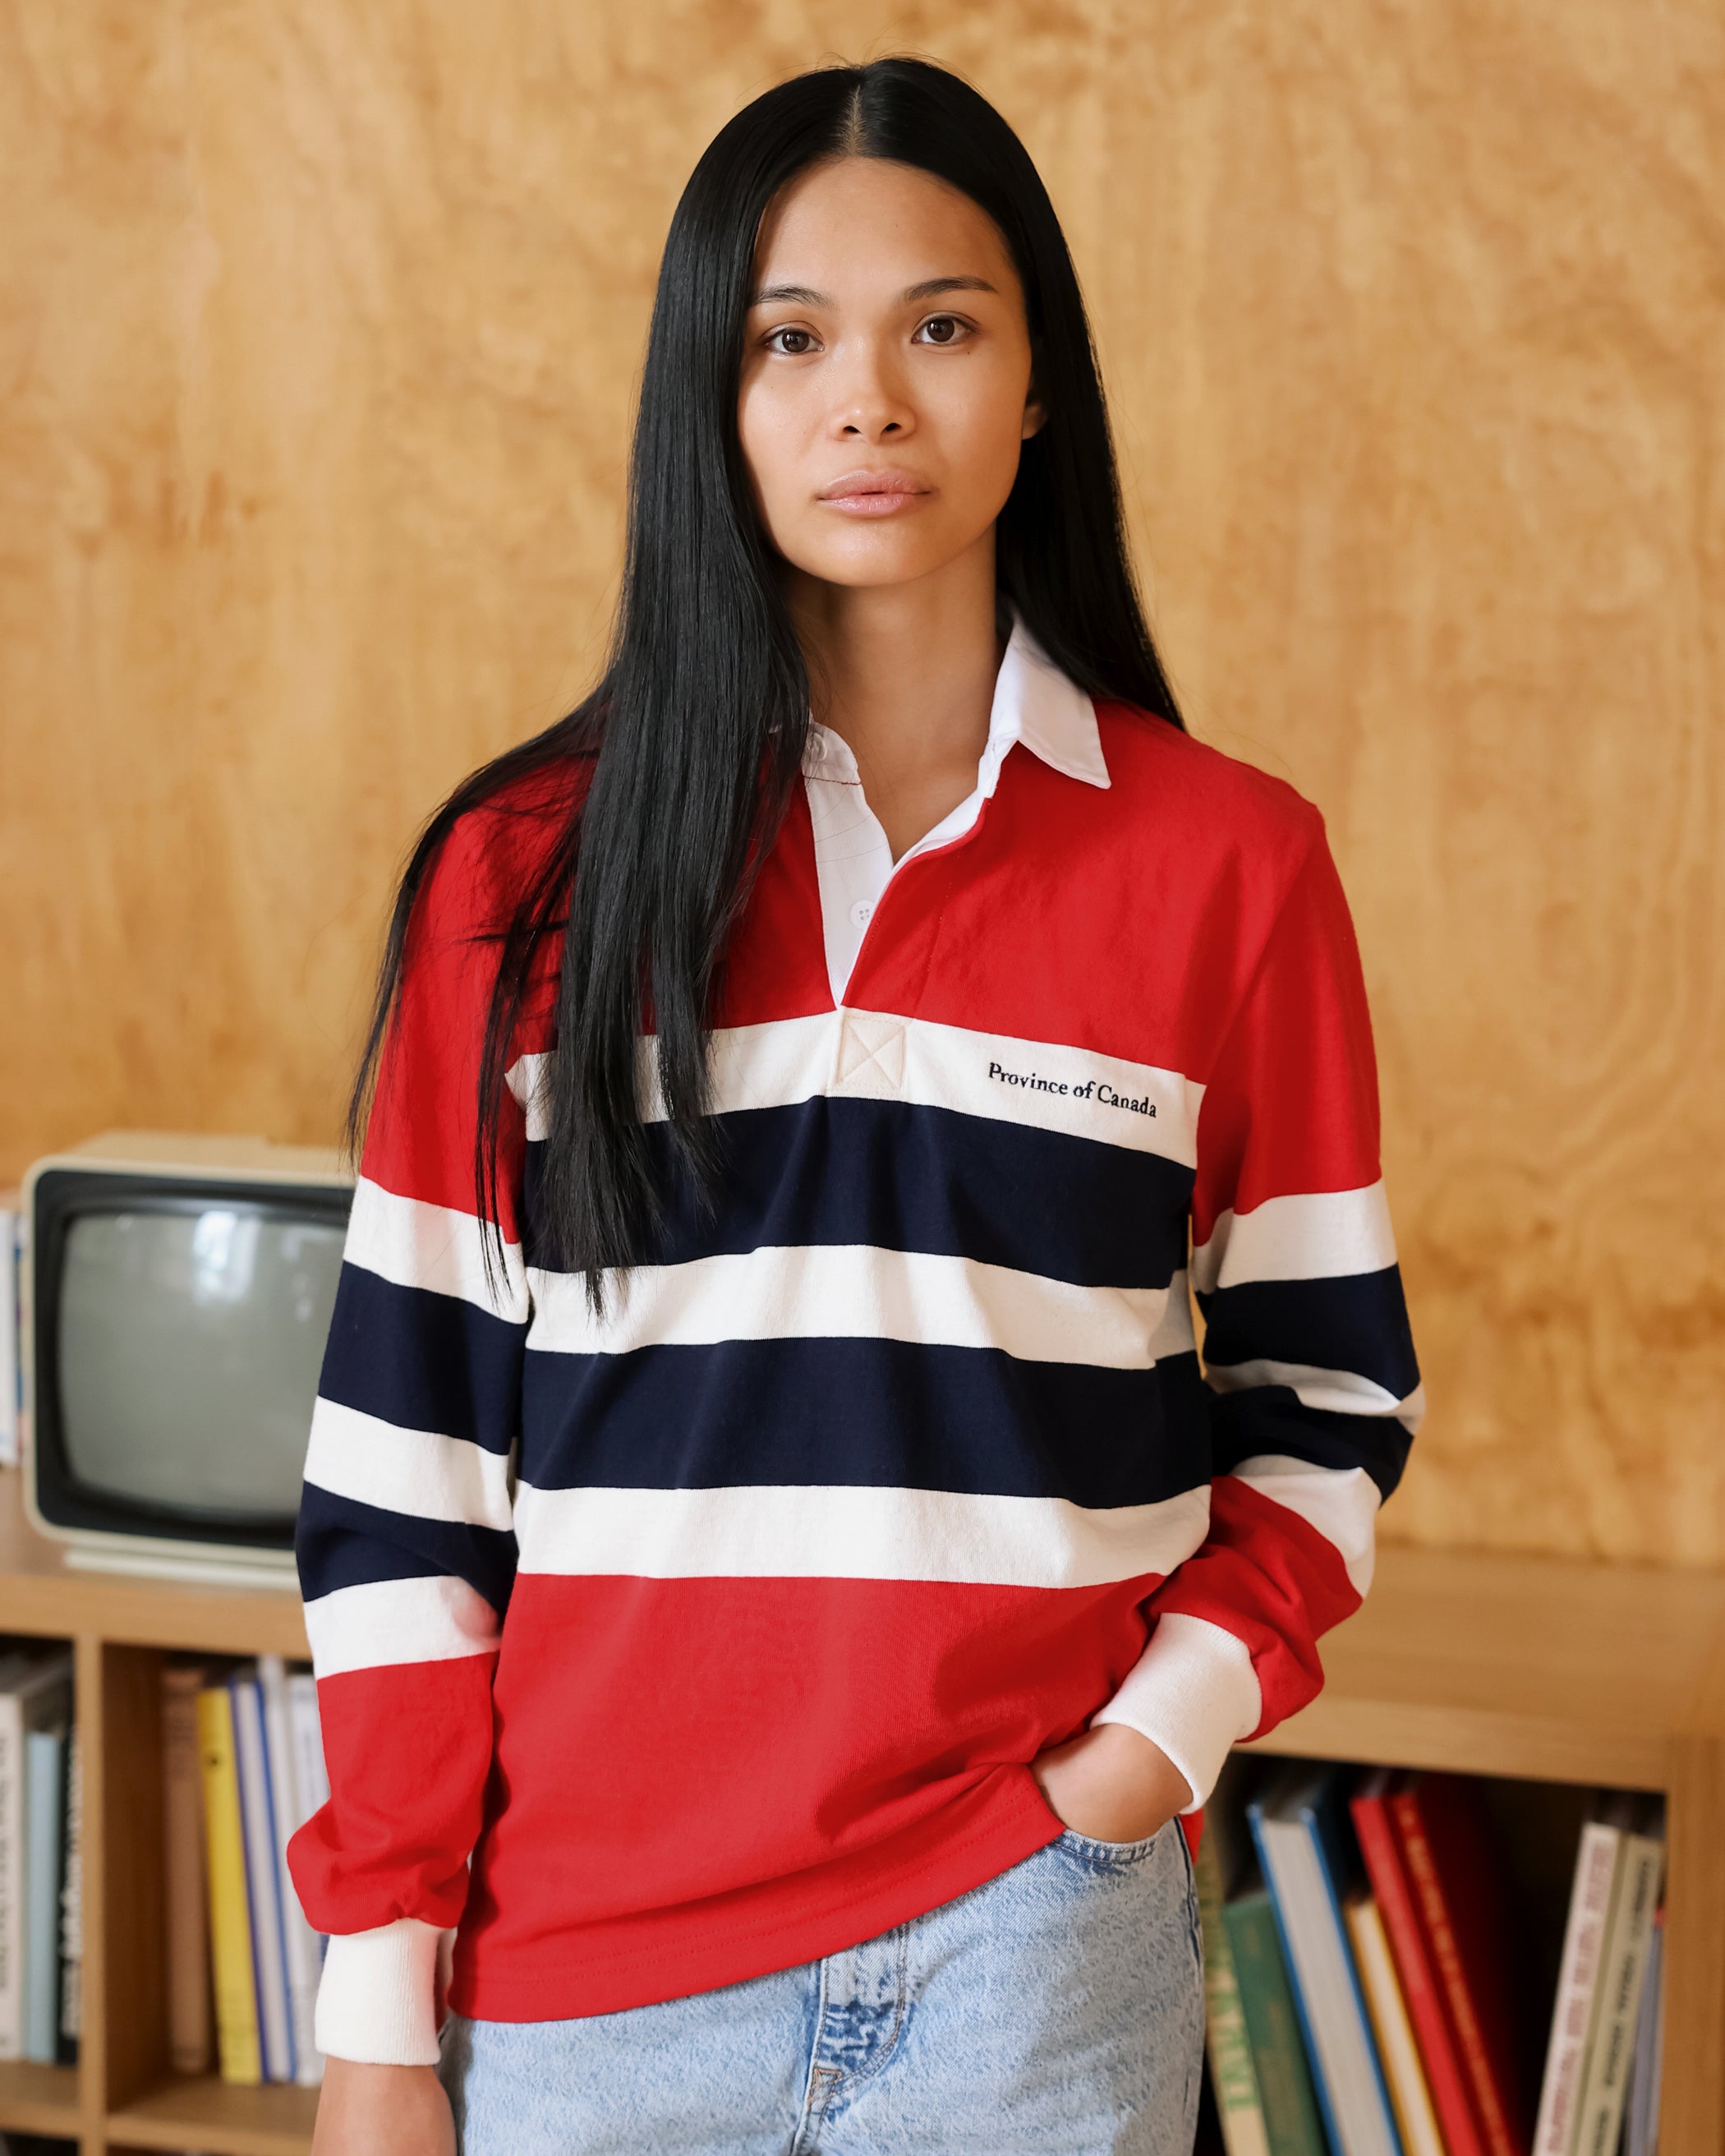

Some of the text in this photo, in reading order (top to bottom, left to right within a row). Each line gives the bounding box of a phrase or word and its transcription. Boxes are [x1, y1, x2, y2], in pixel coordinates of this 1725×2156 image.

[988, 1062, 1157, 1118] Province of Canada
